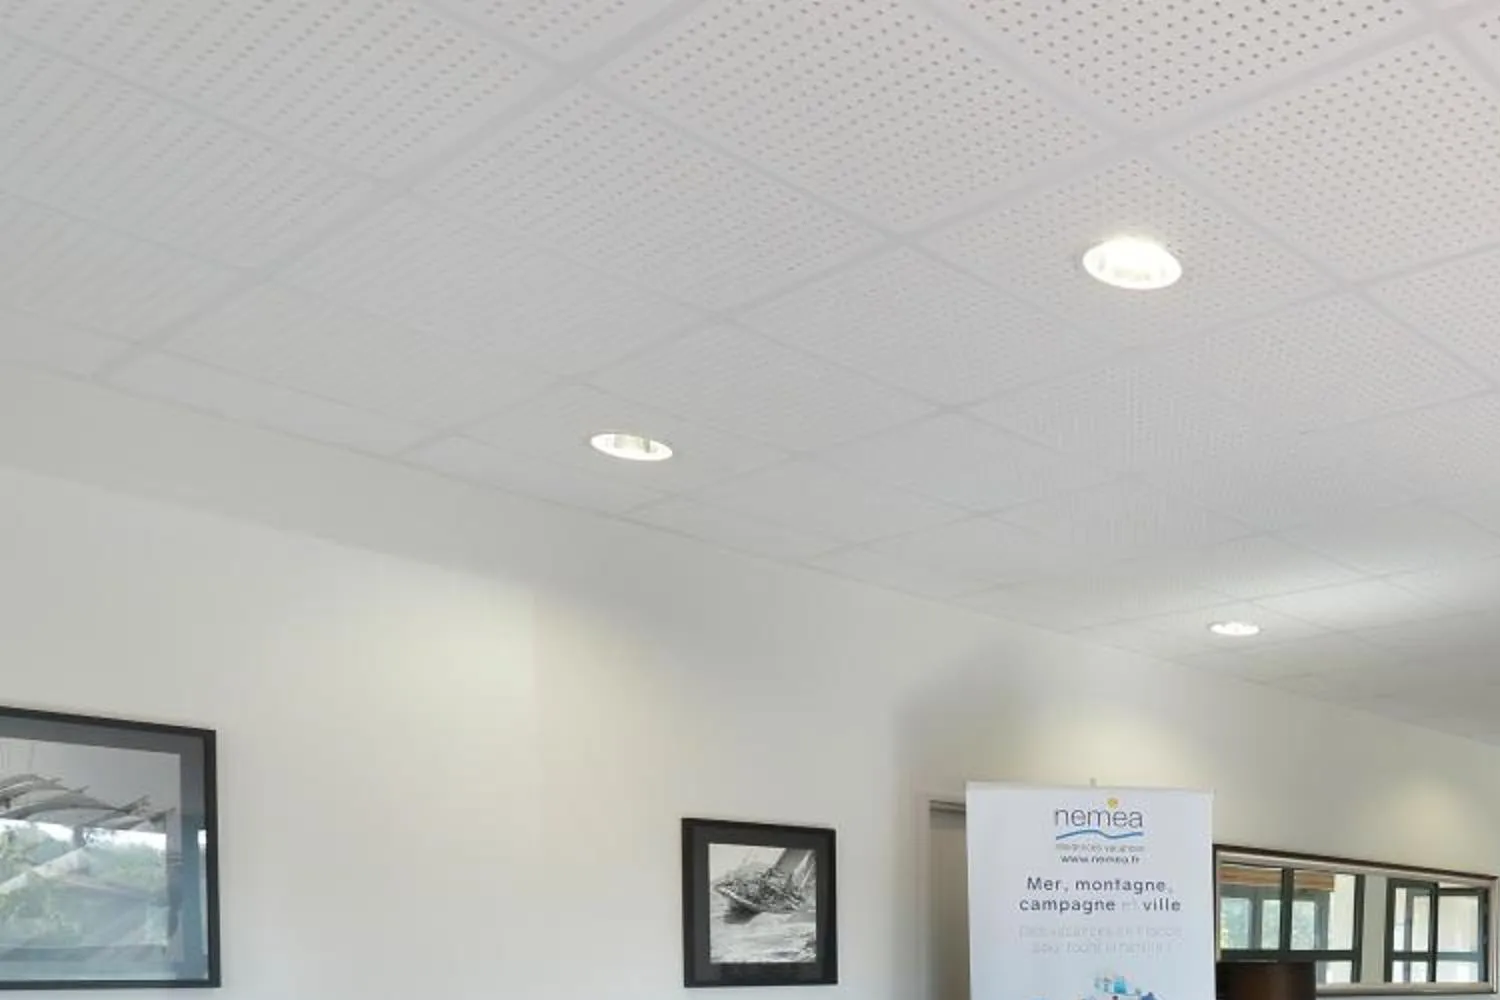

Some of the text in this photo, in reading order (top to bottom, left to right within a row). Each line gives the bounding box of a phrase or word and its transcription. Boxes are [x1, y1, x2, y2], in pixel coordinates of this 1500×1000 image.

[1060, 855, 1140, 864] www.nemea.fr
[1027, 876, 1173, 896] Mer, montagne,
[1019, 898, 1117, 914] campagne
[1143, 897, 1182, 912] ville
